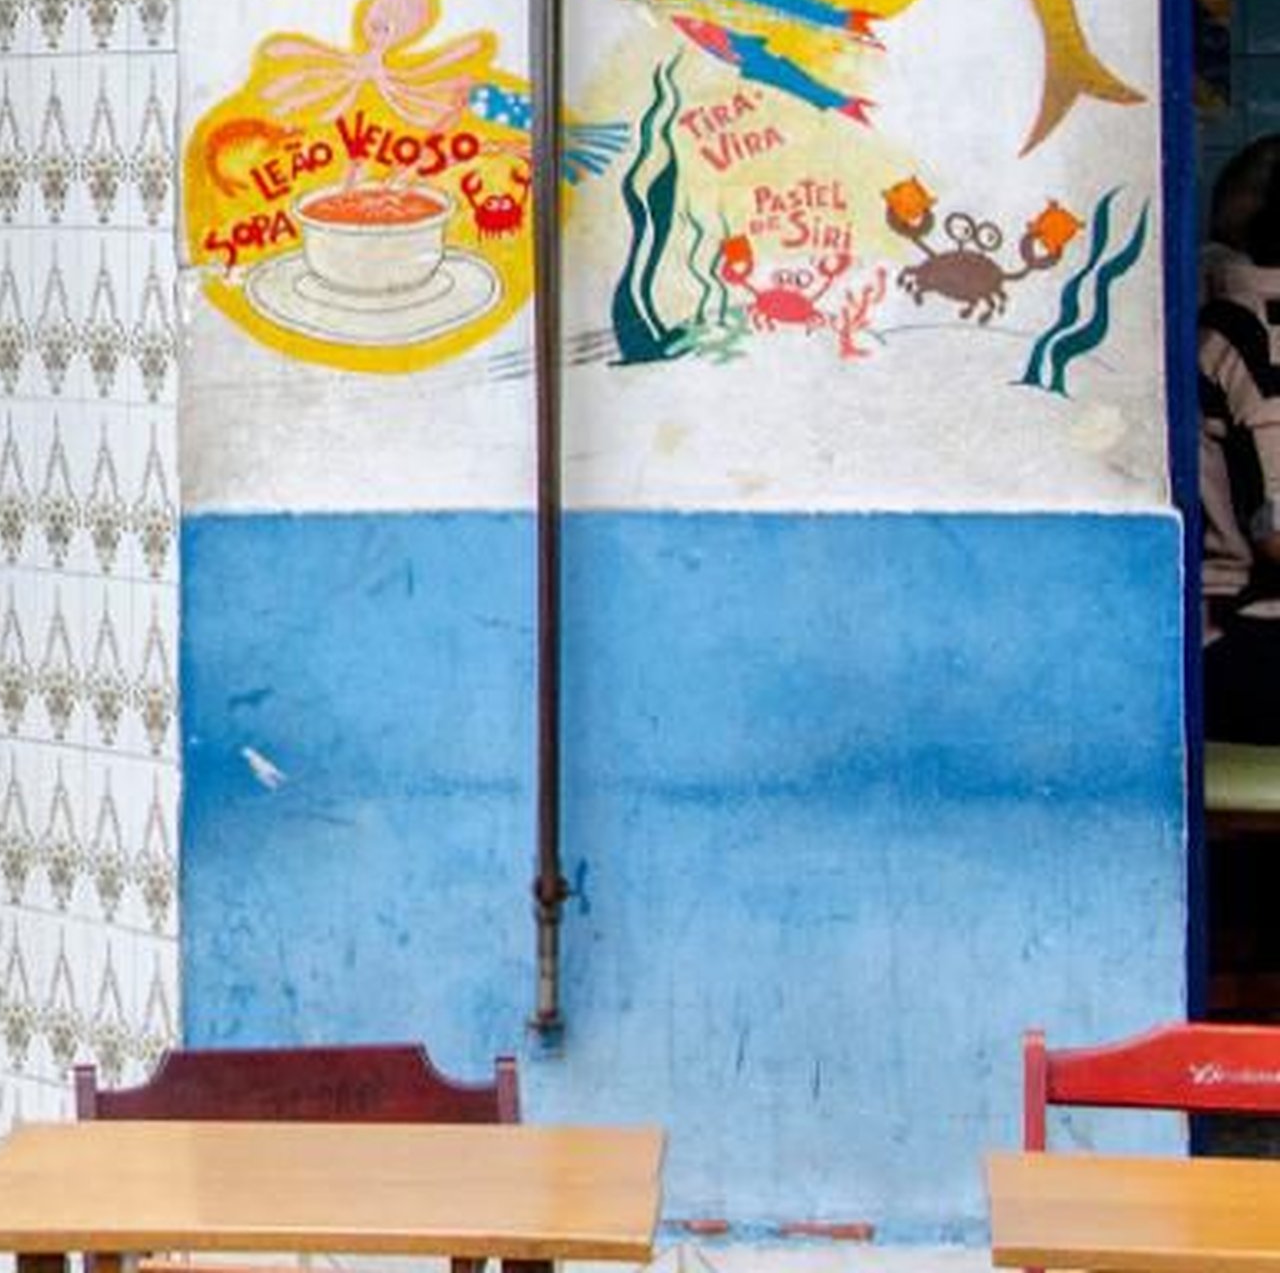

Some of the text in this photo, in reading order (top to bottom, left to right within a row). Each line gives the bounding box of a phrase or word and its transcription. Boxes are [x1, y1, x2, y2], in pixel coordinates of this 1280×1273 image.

[250, 111, 480, 202] LEÃO VELOSO
[754, 180, 847, 215] PASTEL
[204, 208, 296, 275] SOPA
